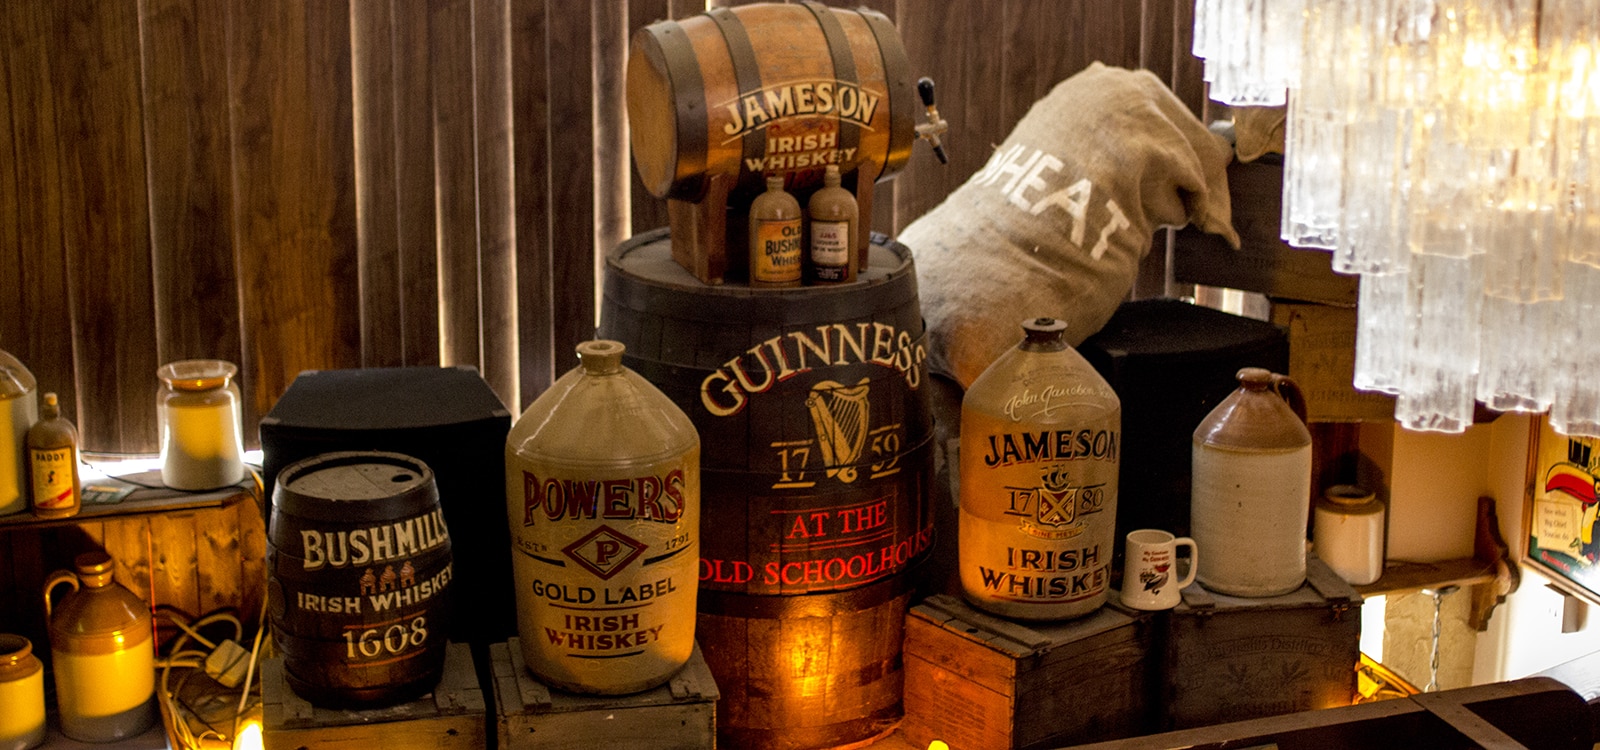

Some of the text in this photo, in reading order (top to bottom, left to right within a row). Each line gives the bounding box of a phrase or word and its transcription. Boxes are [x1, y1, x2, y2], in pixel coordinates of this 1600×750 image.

[724, 82, 879, 135] JAMESON
[768, 132, 837, 154] IRISH
[745, 148, 858, 172] WHISKEY
[701, 321, 927, 417] GUINNESS
[36, 453, 65, 462] PADDY
[776, 432, 900, 483] 17 59
[984, 429, 1119, 470] JAMESON
[522, 469, 686, 527] POWERS
[1009, 488, 1104, 512] 17 80
[785, 501, 888, 540] AT THE
[301, 508, 449, 571] BUSHMILLS
[596, 540, 621, 566] P
[665, 531, 690, 551] 1791
[699, 558, 754, 583] OLD
[1007, 545, 1100, 574] IRISH
[298, 561, 453, 614] IRISH WHISKEY
[533, 577, 676, 605] GOLD LABEL
[979, 563, 1112, 599] WHISKEY
[343, 616, 428, 658] 1608
[544, 624, 665, 650] WHISKEY
[565, 613, 639, 632] IRISH
